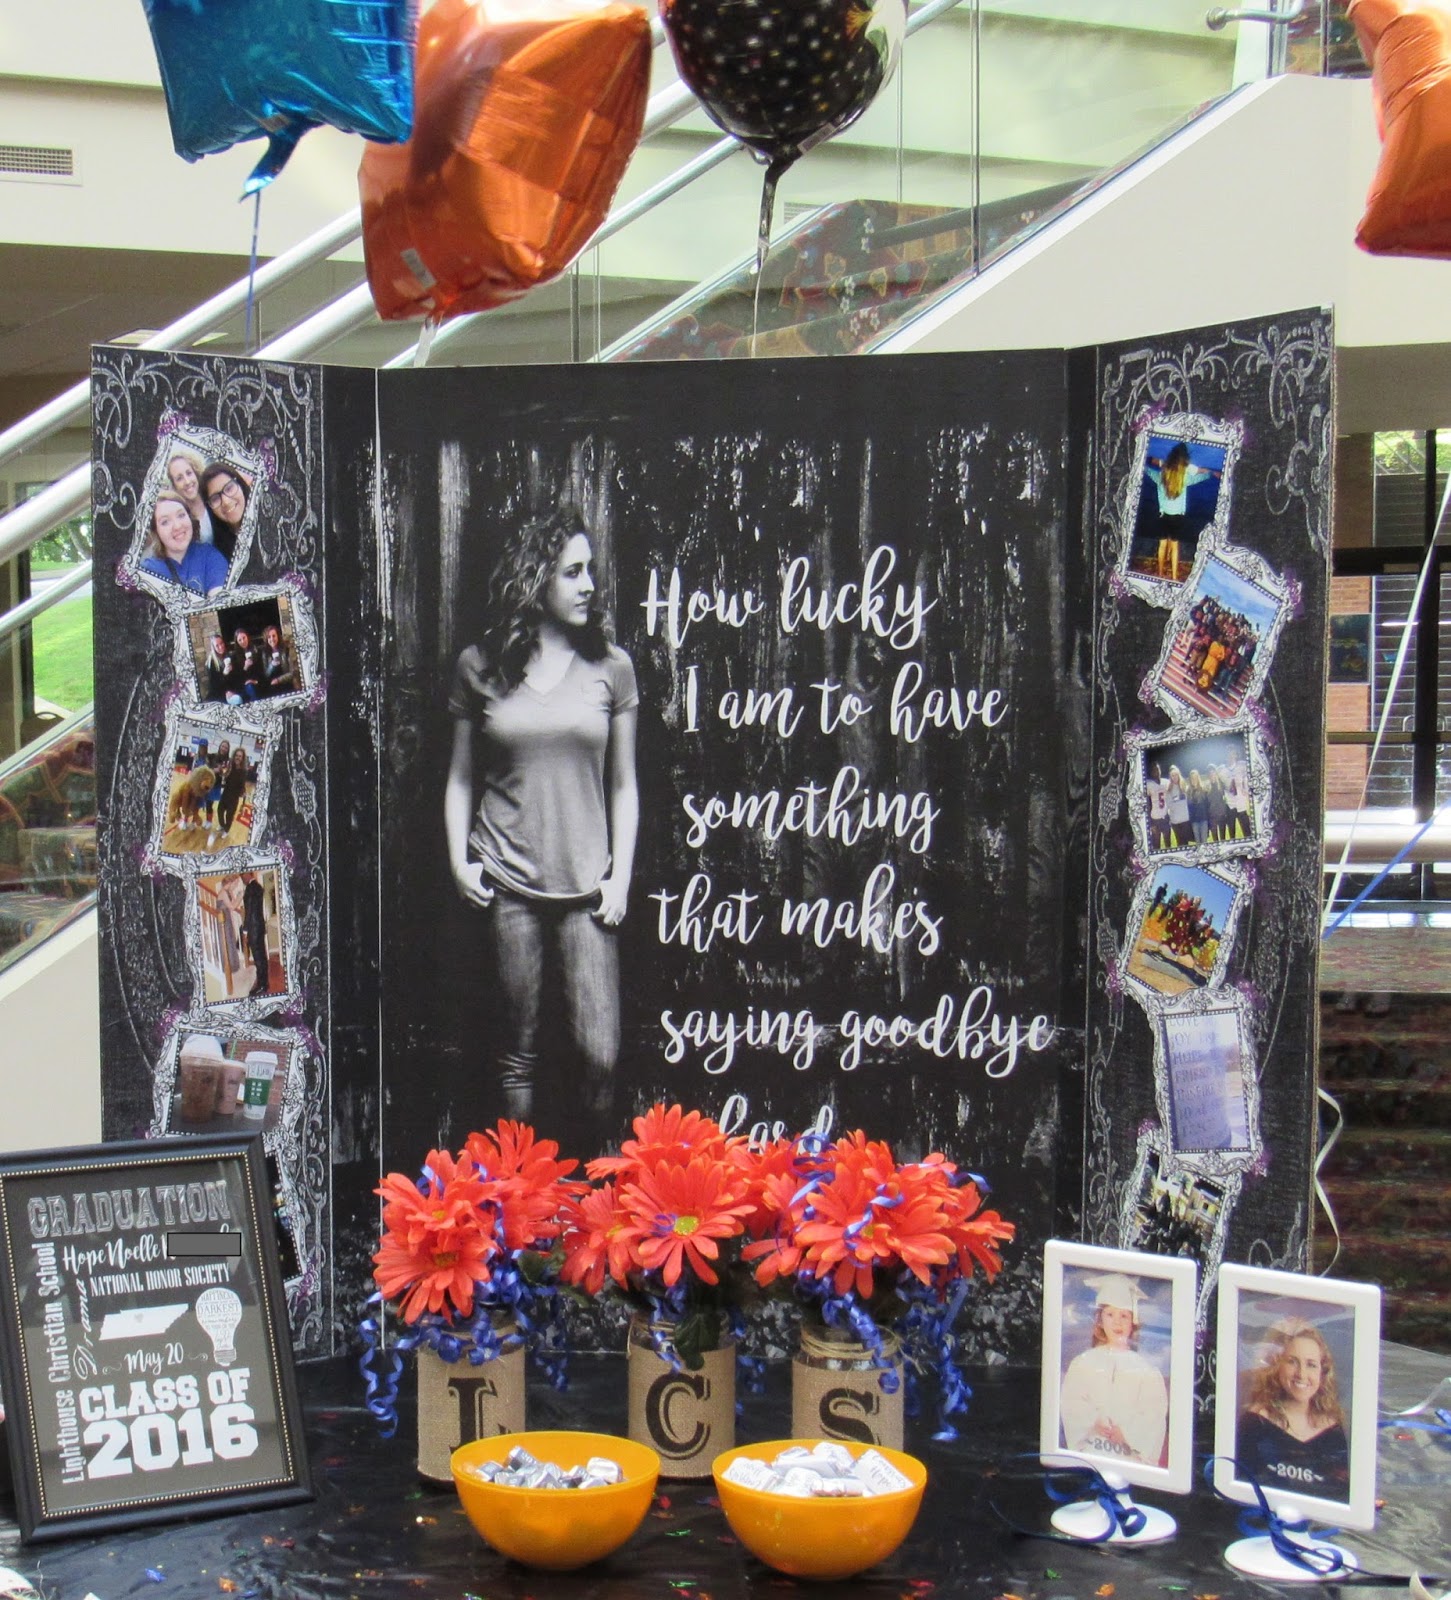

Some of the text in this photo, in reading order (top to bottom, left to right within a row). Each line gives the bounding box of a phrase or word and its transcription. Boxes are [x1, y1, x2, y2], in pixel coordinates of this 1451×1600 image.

[640, 545, 938, 650] How lucky
[684, 661, 1008, 743] I am to have
[682, 765, 940, 854] something
[647, 863, 943, 955] that makes
[660, 985, 1055, 1078] saying goodbye
[27, 1180, 231, 1238] GRADUATION
[62, 1240, 106, 1274] Hope
[105, 1238, 160, 1271] Noelle
[90, 1262, 230, 1297] NATIONAL HONOR SOCIETY
[36, 1241, 85, 1484] Lighthouse Christian School
[79, 1368, 250, 1421] CLASS OF
[125, 1342, 184, 1375] May 20
[83, 1403, 259, 1479] 2016
[644, 1372, 710, 1460] C
[819, 1387, 881, 1445] S
